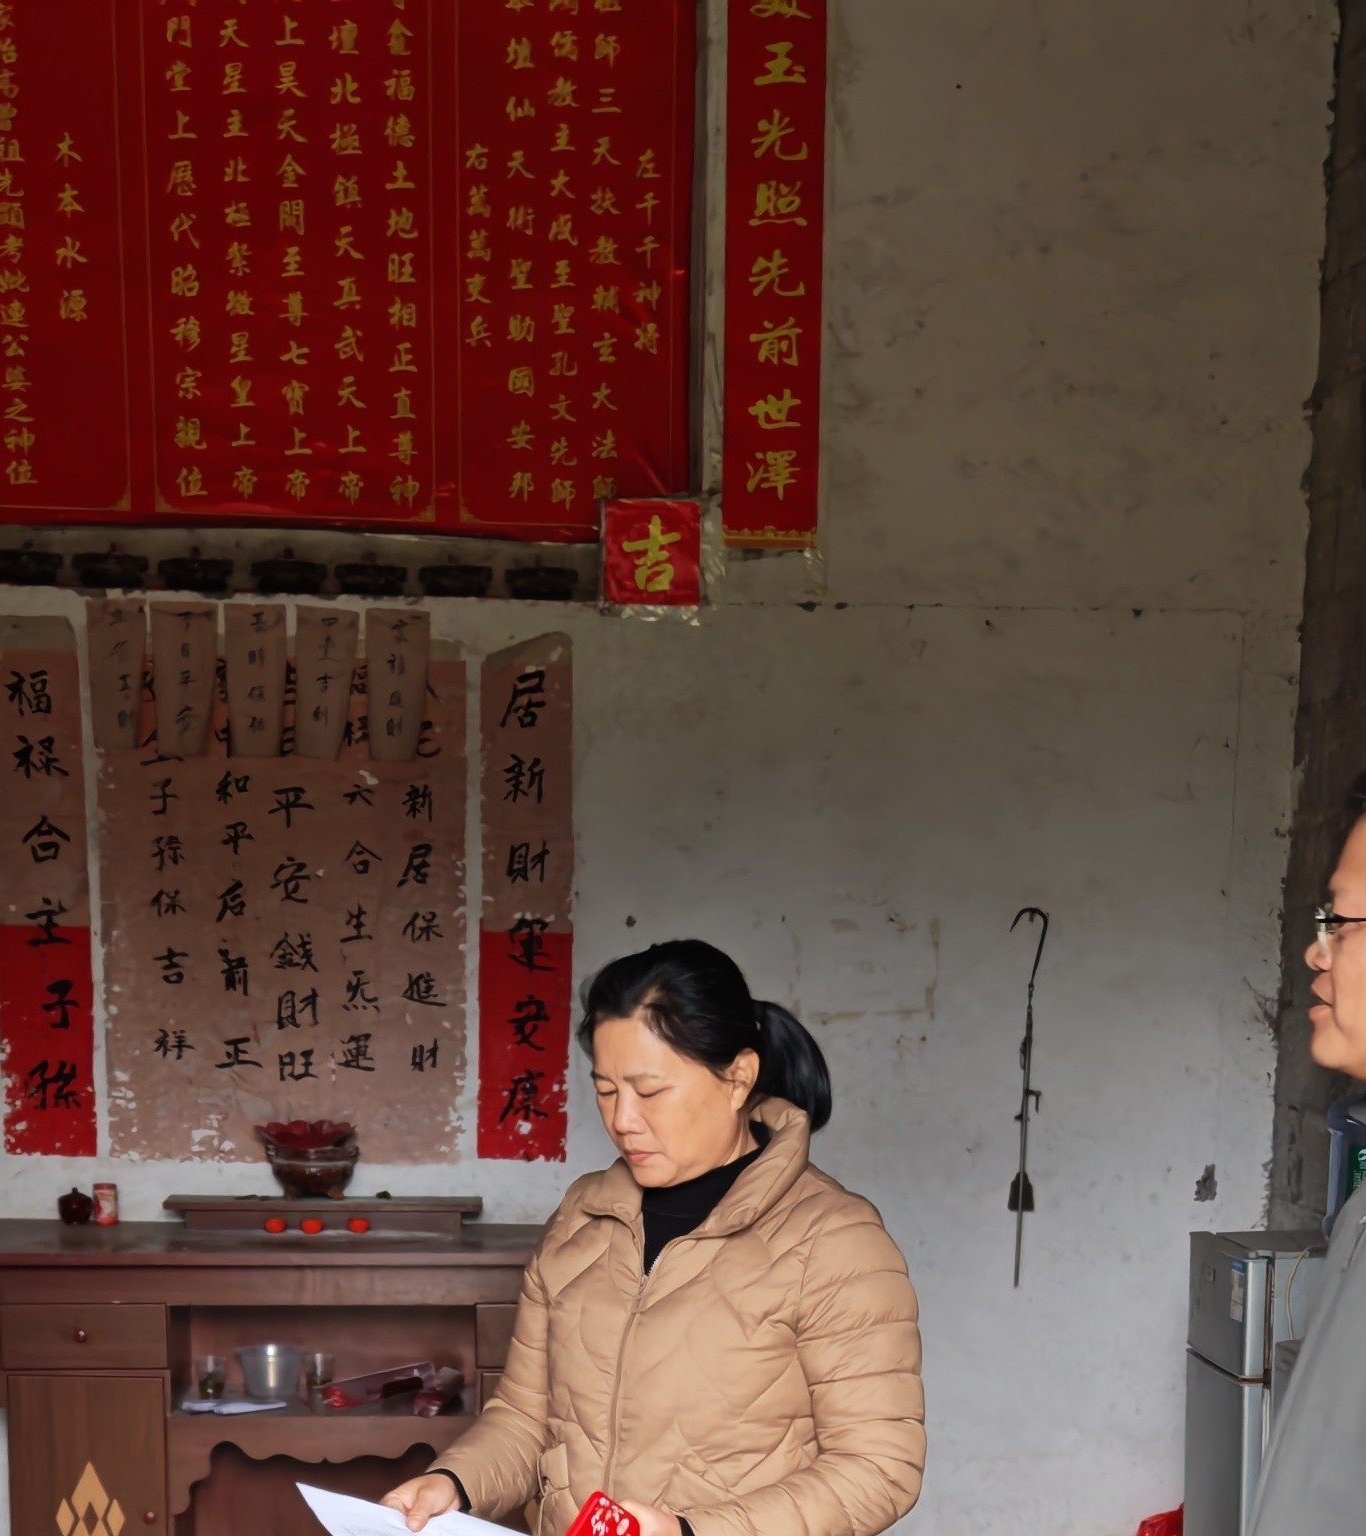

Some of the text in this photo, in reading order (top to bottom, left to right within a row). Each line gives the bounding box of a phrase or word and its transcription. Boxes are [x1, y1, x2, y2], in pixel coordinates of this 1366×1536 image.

[54, 133, 89, 323] 木本水源
[622, 515, 684, 594] 吉
